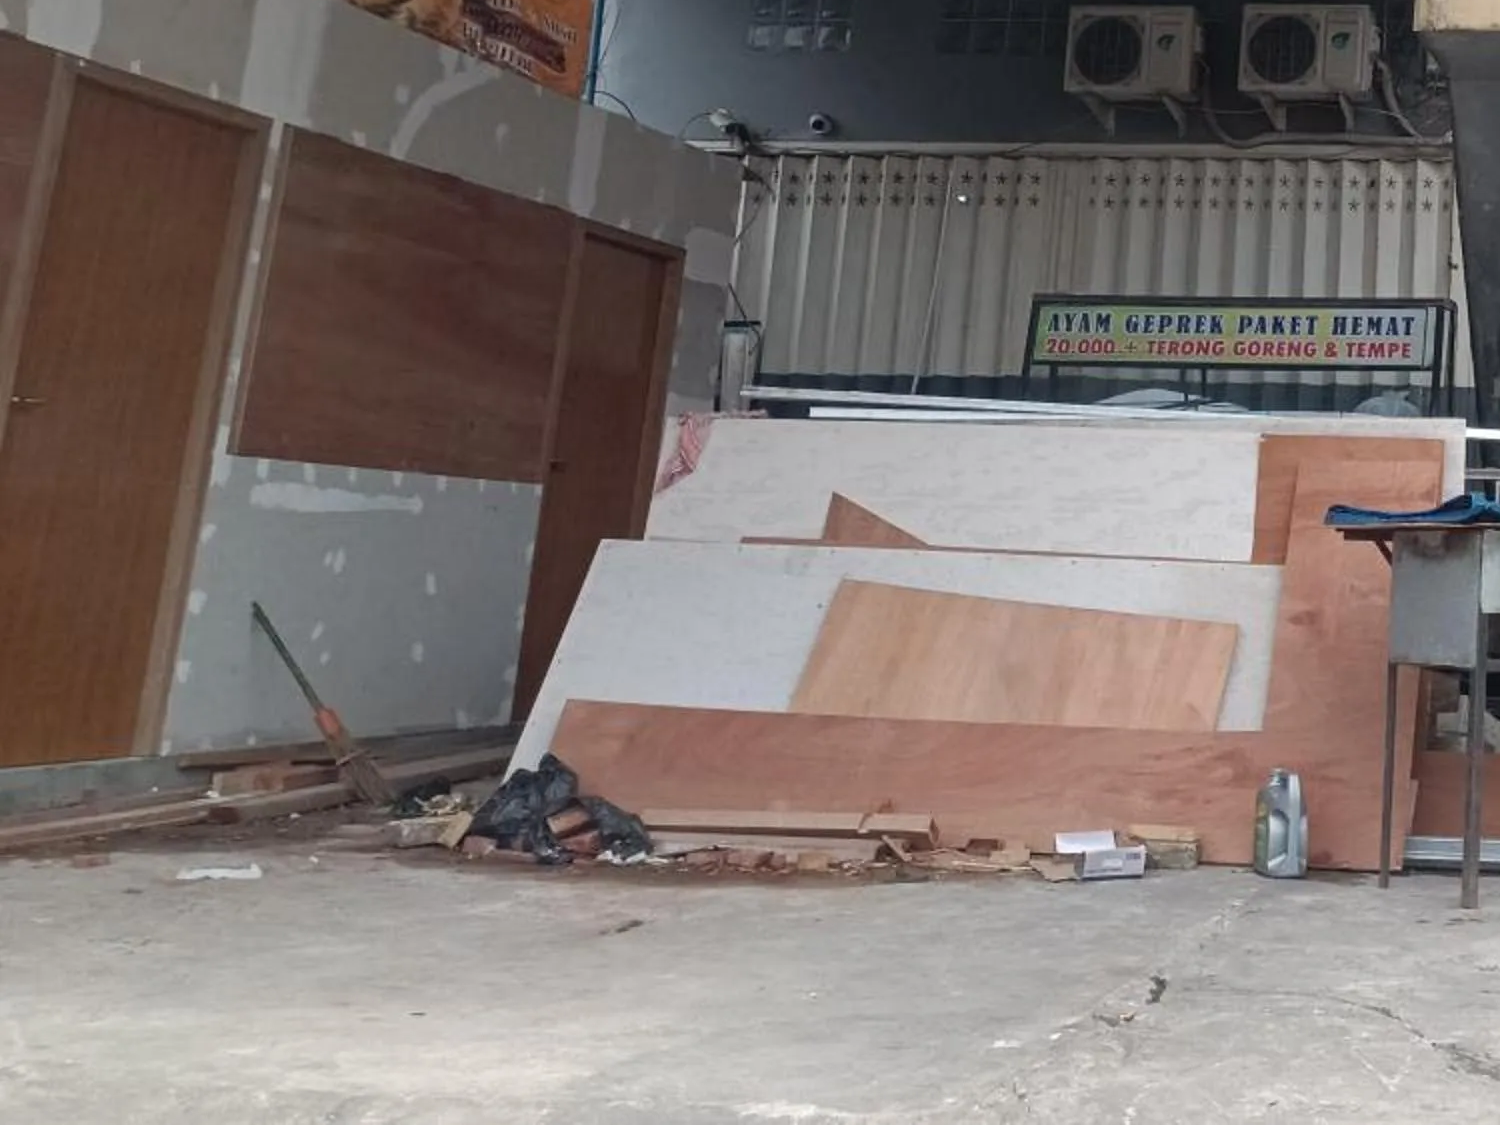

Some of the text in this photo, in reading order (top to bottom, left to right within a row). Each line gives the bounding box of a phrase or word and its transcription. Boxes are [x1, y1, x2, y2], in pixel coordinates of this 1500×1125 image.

[1047, 312, 1416, 337] AYAM GEPREK PAKET HEMAT
[1046, 338, 1115, 355] 20.000
[1146, 339, 1226, 357] TERONG
[1233, 340, 1318, 358] GORENG
[1323, 341, 1339, 358] &
[1345, 341, 1413, 359] TEMPE
